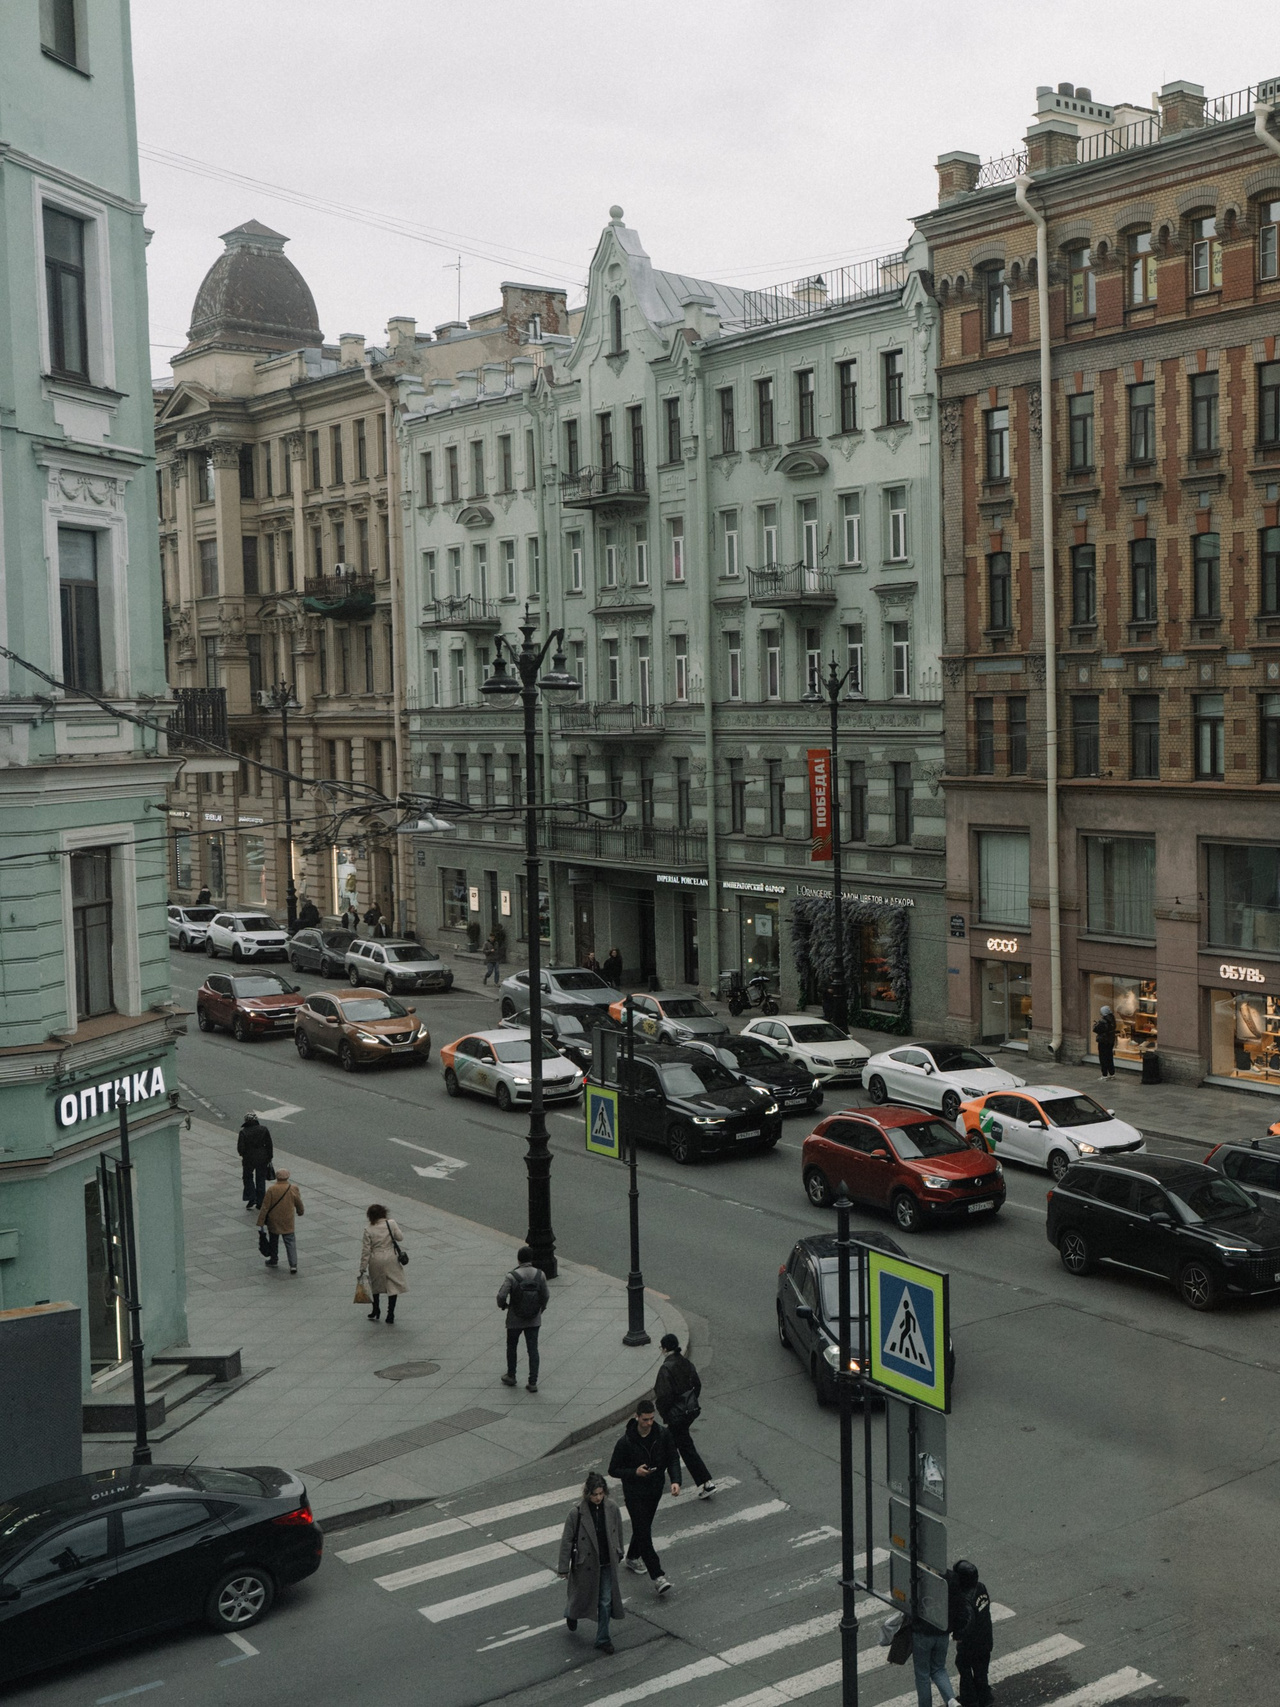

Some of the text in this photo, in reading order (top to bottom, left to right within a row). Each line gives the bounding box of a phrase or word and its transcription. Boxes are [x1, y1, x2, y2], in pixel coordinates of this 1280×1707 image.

[814, 758, 827, 828] ПОБЕДА!
[656, 874, 709, 886] IMPERIAL PORCELAIN
[722, 881, 786, 894] ИМПЕРАТОРСКИЙ ФАРФОР
[987, 938, 1017, 953] ecco
[1220, 965, 1265, 983] ОБУВЬ
[60, 1066, 166, 1127] ОПТИКА
